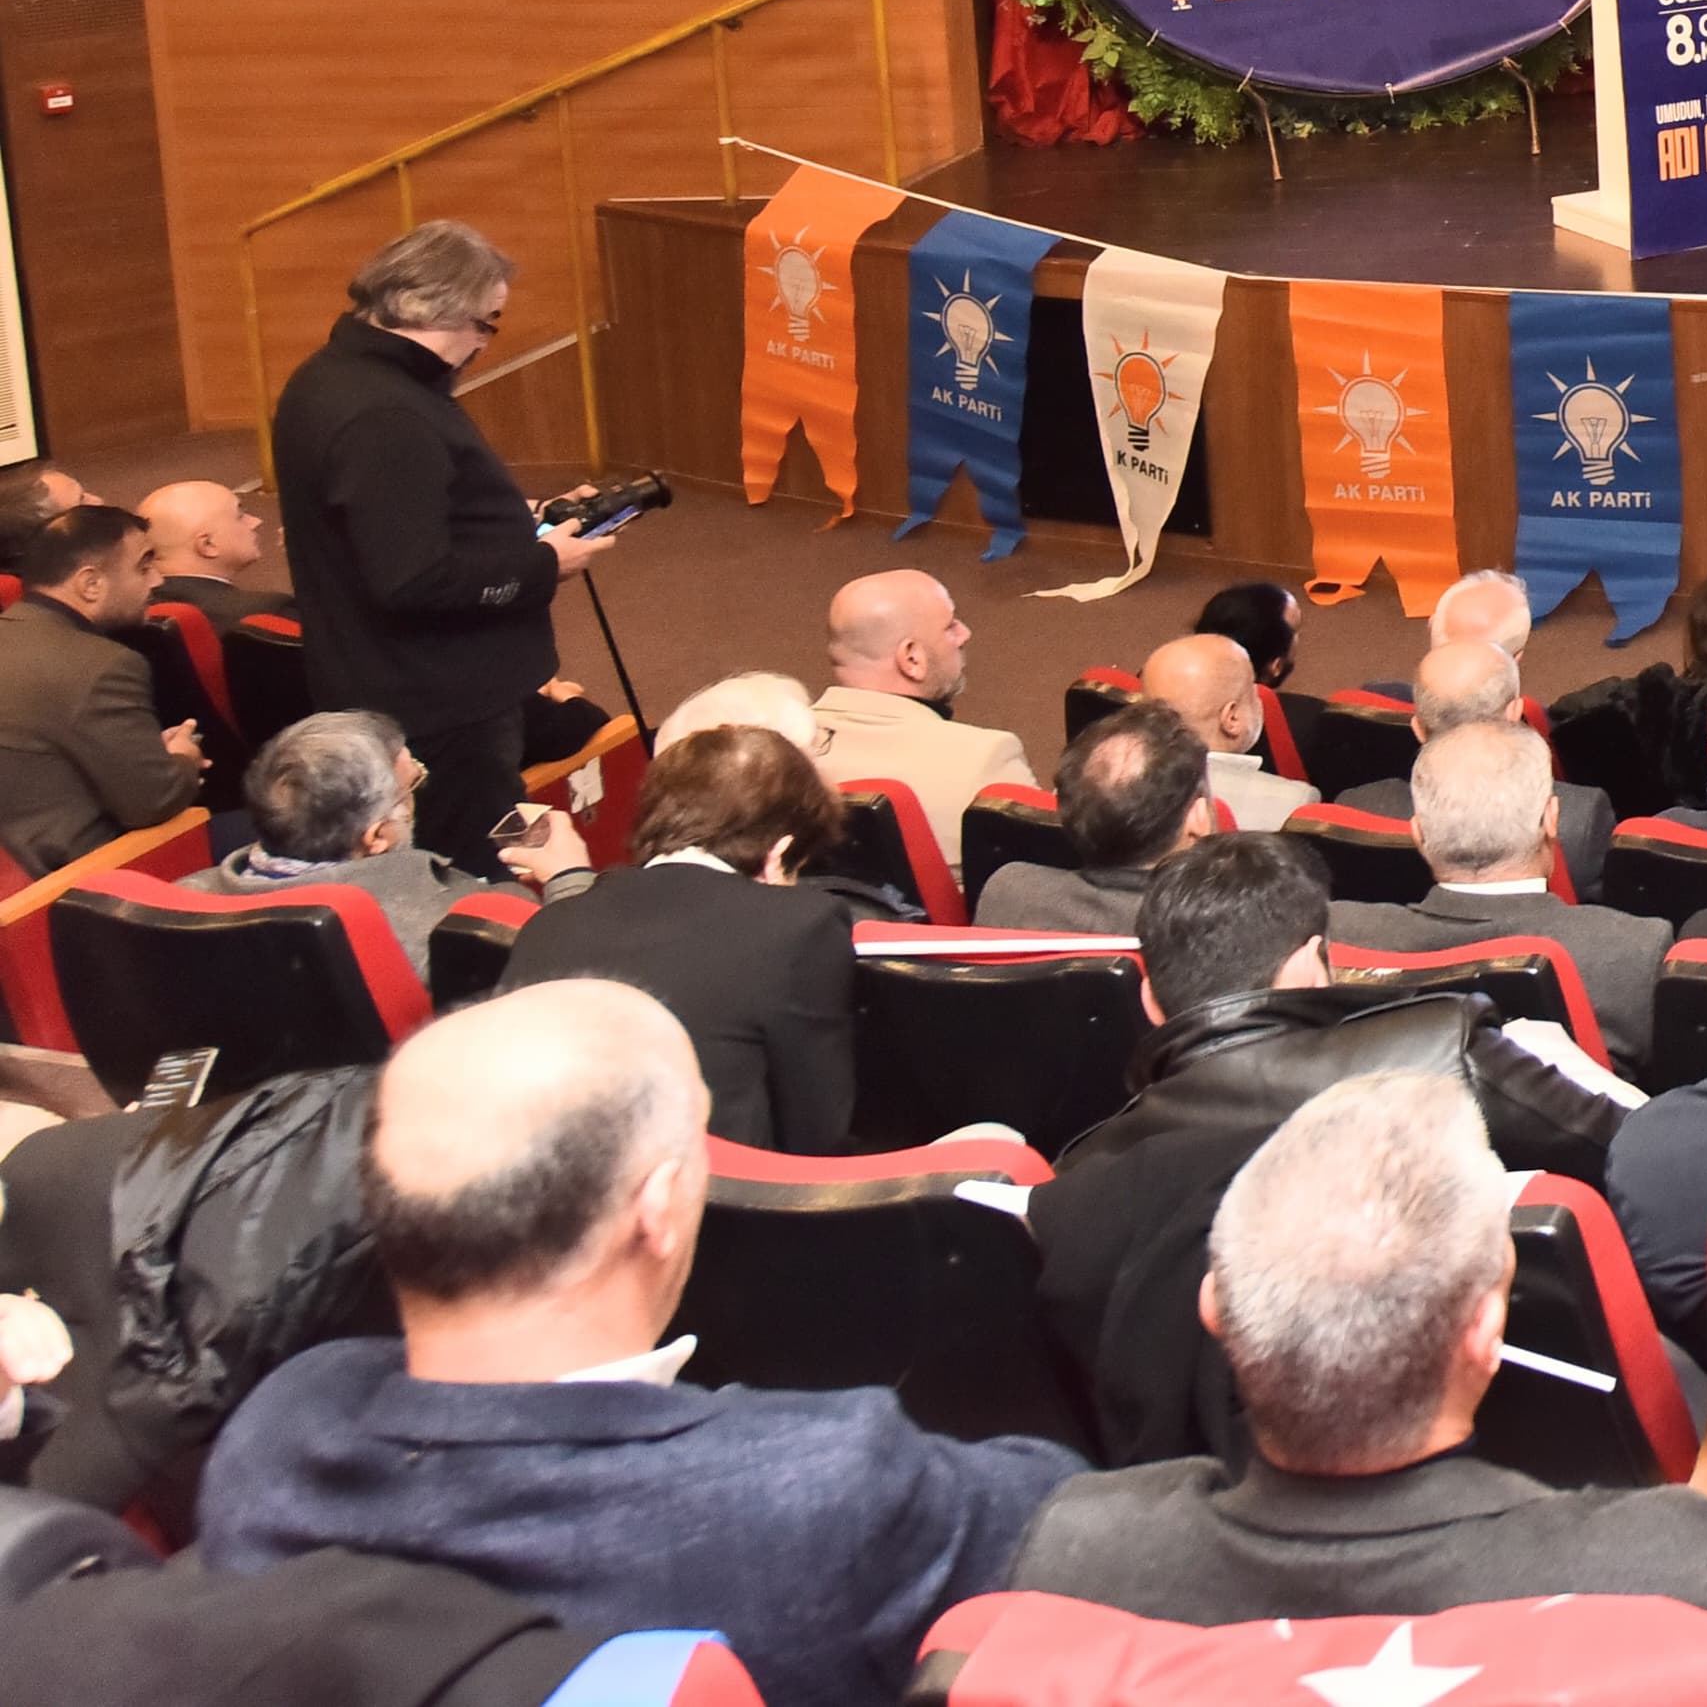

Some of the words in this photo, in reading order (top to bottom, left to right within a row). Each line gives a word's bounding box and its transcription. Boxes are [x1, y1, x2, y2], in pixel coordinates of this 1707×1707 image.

[1665, 12, 1702, 67] 8.
[1655, 100, 1705, 126] UMUDUN,
[1657, 126, 1700, 183] ADI
[766, 338, 789, 359] AK
[932, 385, 955, 407] AK
[1334, 483, 1362, 501] AK
[1551, 491, 1582, 510] AK
